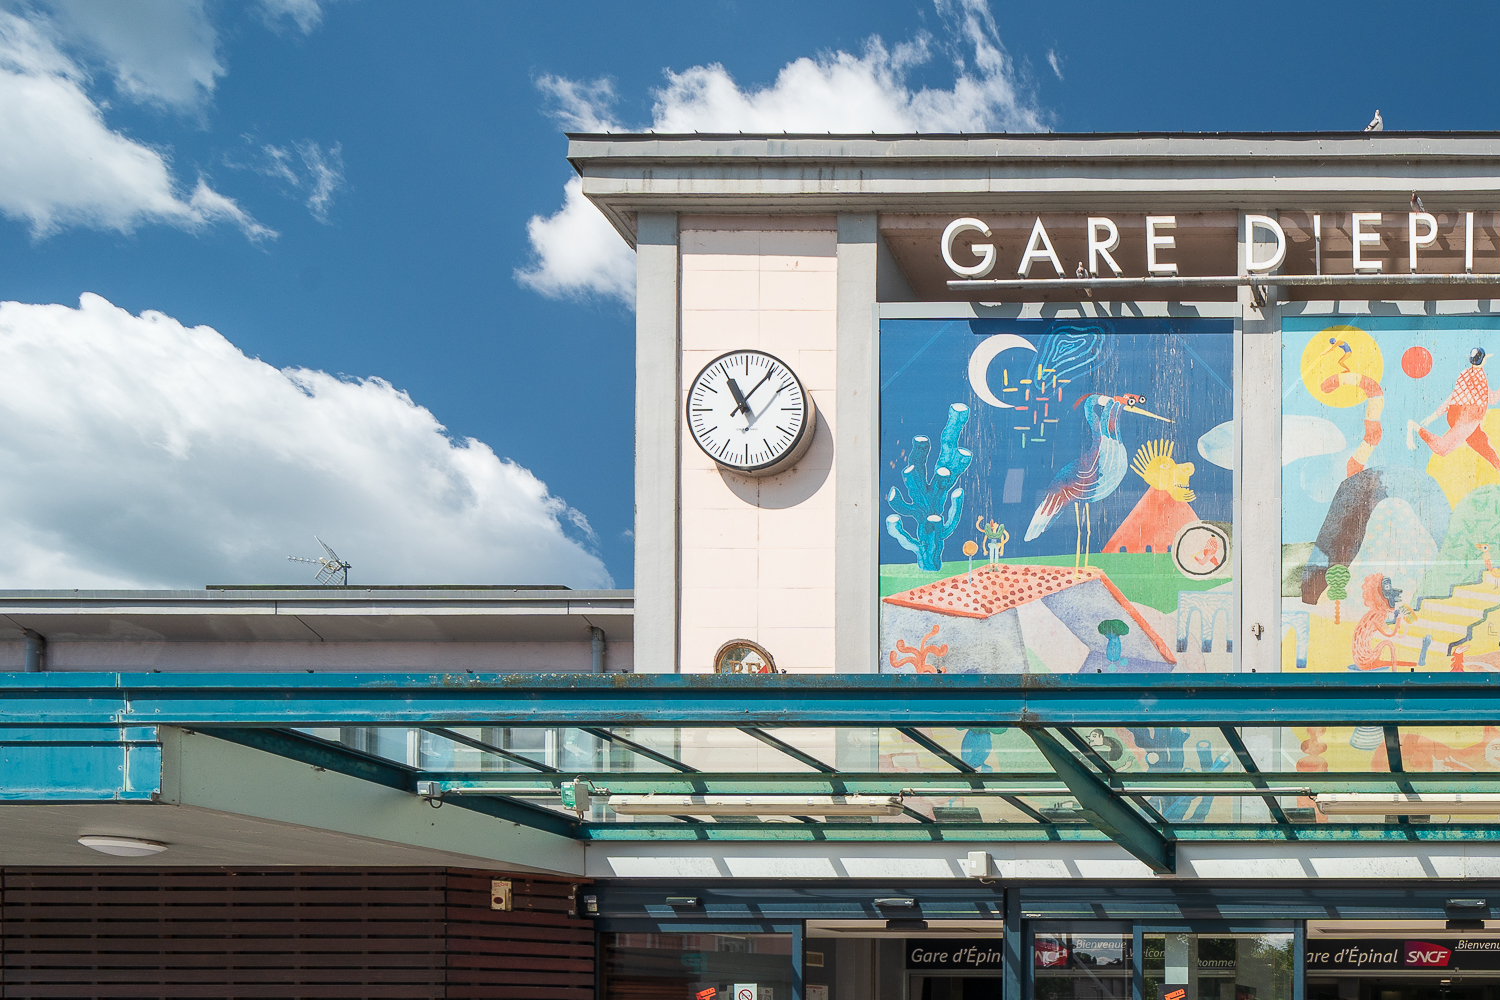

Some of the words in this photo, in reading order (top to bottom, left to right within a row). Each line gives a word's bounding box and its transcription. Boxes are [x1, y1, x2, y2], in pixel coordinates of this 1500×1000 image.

[940, 215, 1179, 280] GARE
[911, 948, 947, 963] Gare
[1406, 951, 1449, 963] SNCF
